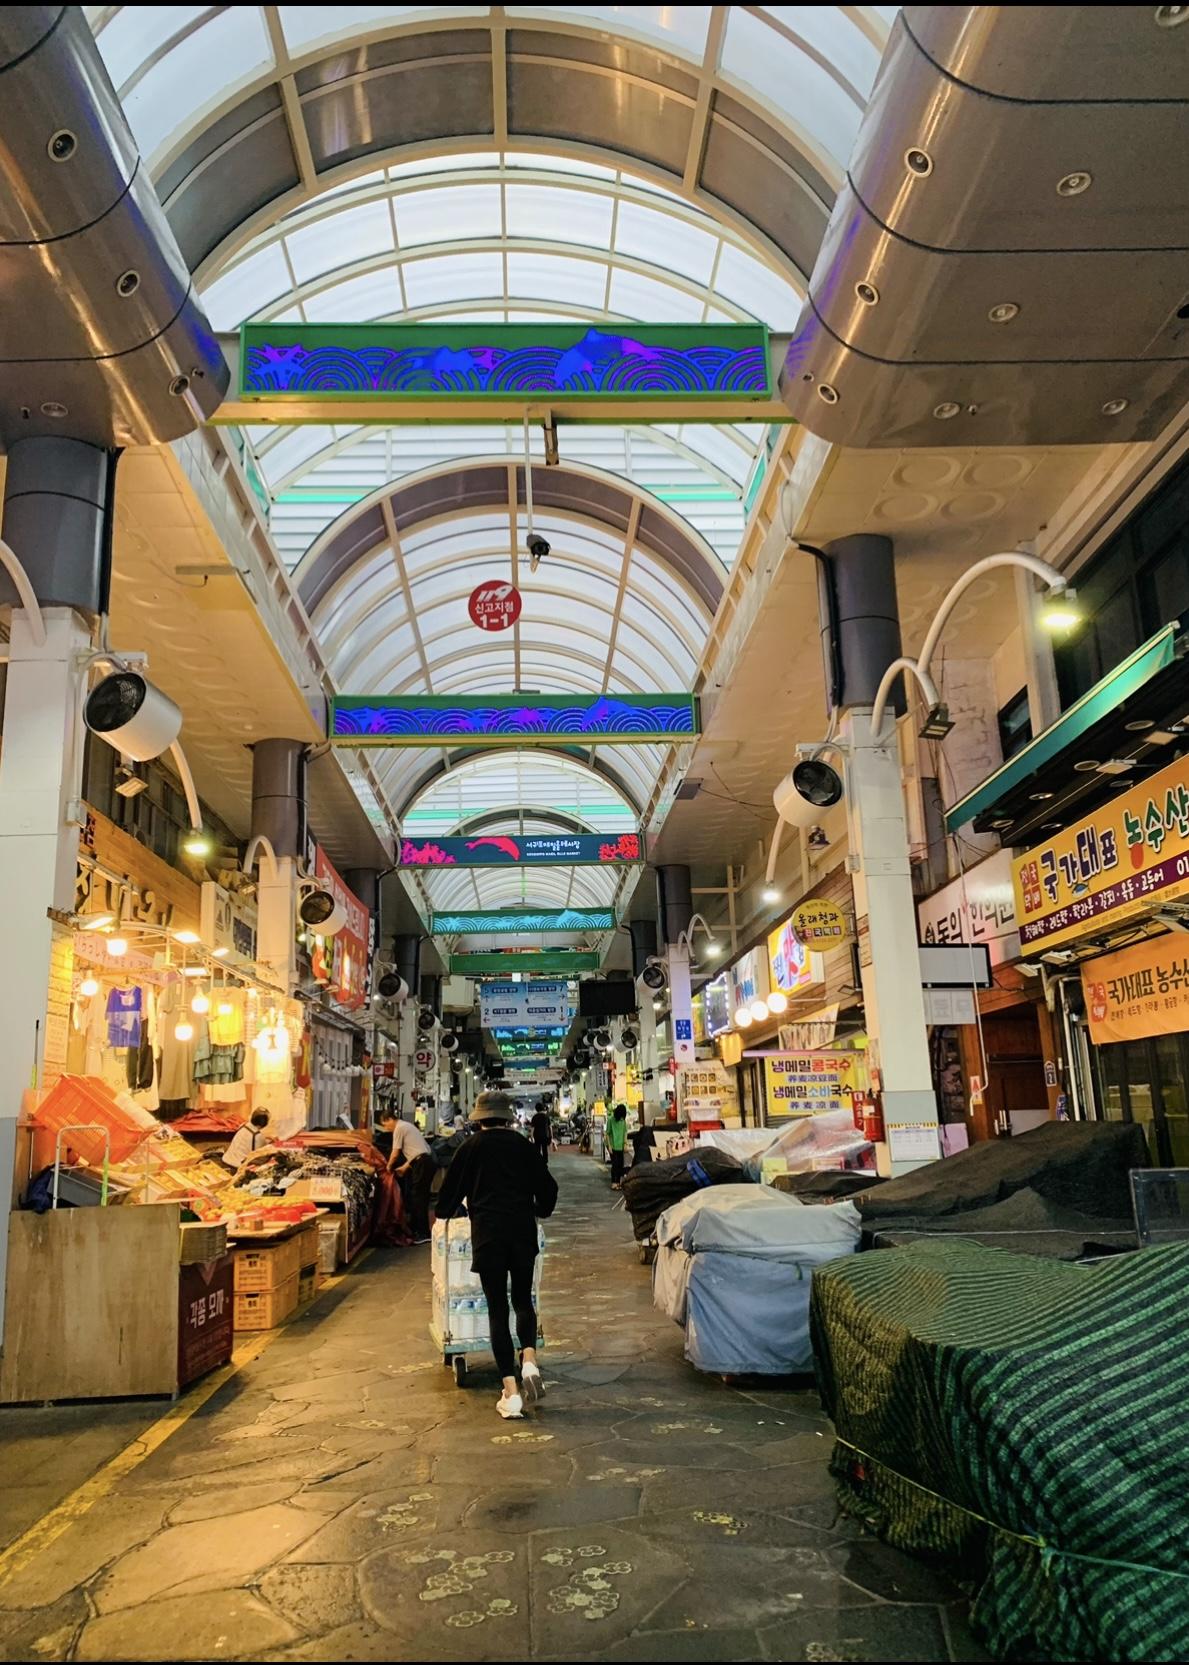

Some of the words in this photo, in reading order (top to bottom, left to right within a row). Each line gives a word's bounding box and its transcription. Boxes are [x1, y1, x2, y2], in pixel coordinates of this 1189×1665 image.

[475, 602, 514, 614] 신고지점
[480, 613, 509, 628] 1-1
[1040, 824, 1118, 904] 국가대표
[798, 911, 839, 928] 올래청과
[1107, 968, 1156, 1005] 국가대표
[190, 1297, 206, 1329] 각종
